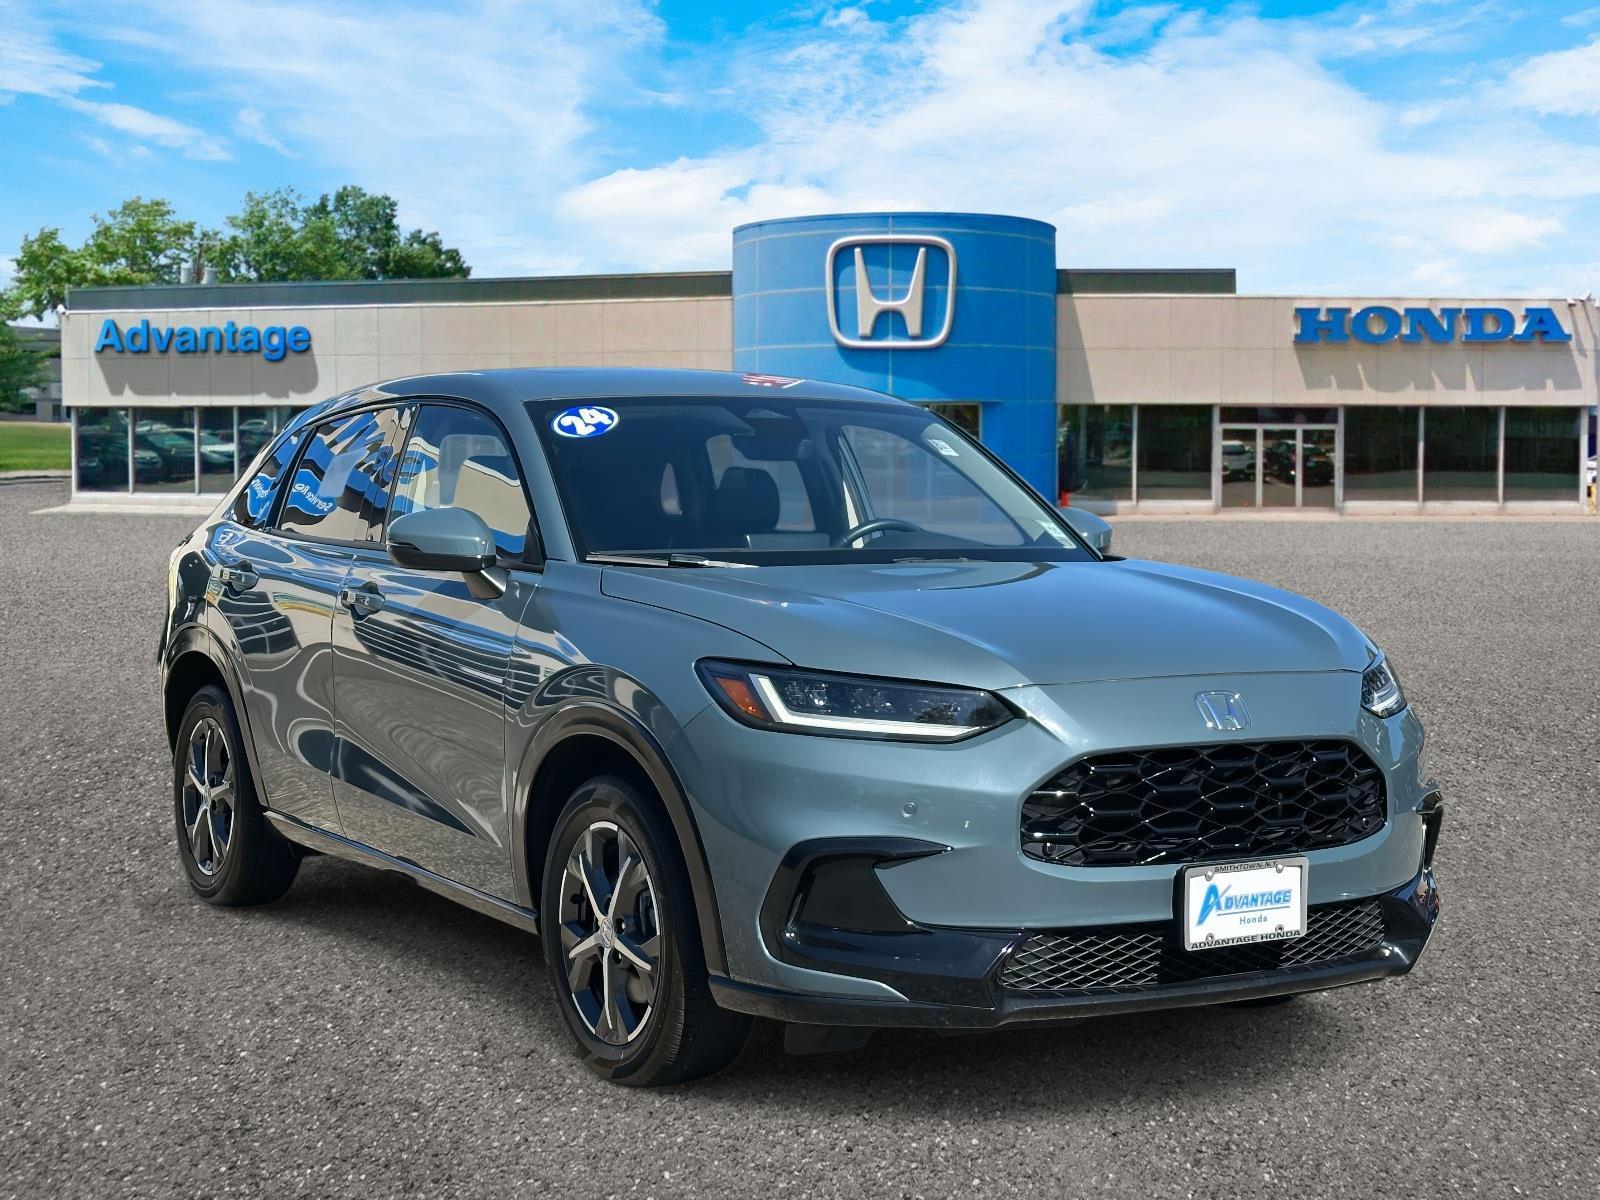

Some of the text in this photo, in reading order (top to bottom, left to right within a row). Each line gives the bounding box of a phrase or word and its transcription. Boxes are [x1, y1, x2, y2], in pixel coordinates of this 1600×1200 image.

[95, 318, 312, 362] Advantage
[1293, 305, 1572, 343] HONDA
[560, 408, 612, 435] 24
[1196, 883, 1292, 926] ADVANTAGE
[1239, 914, 1268, 925] Honda
[1191, 930, 1301, 949] ADVANTAGE HONDA
